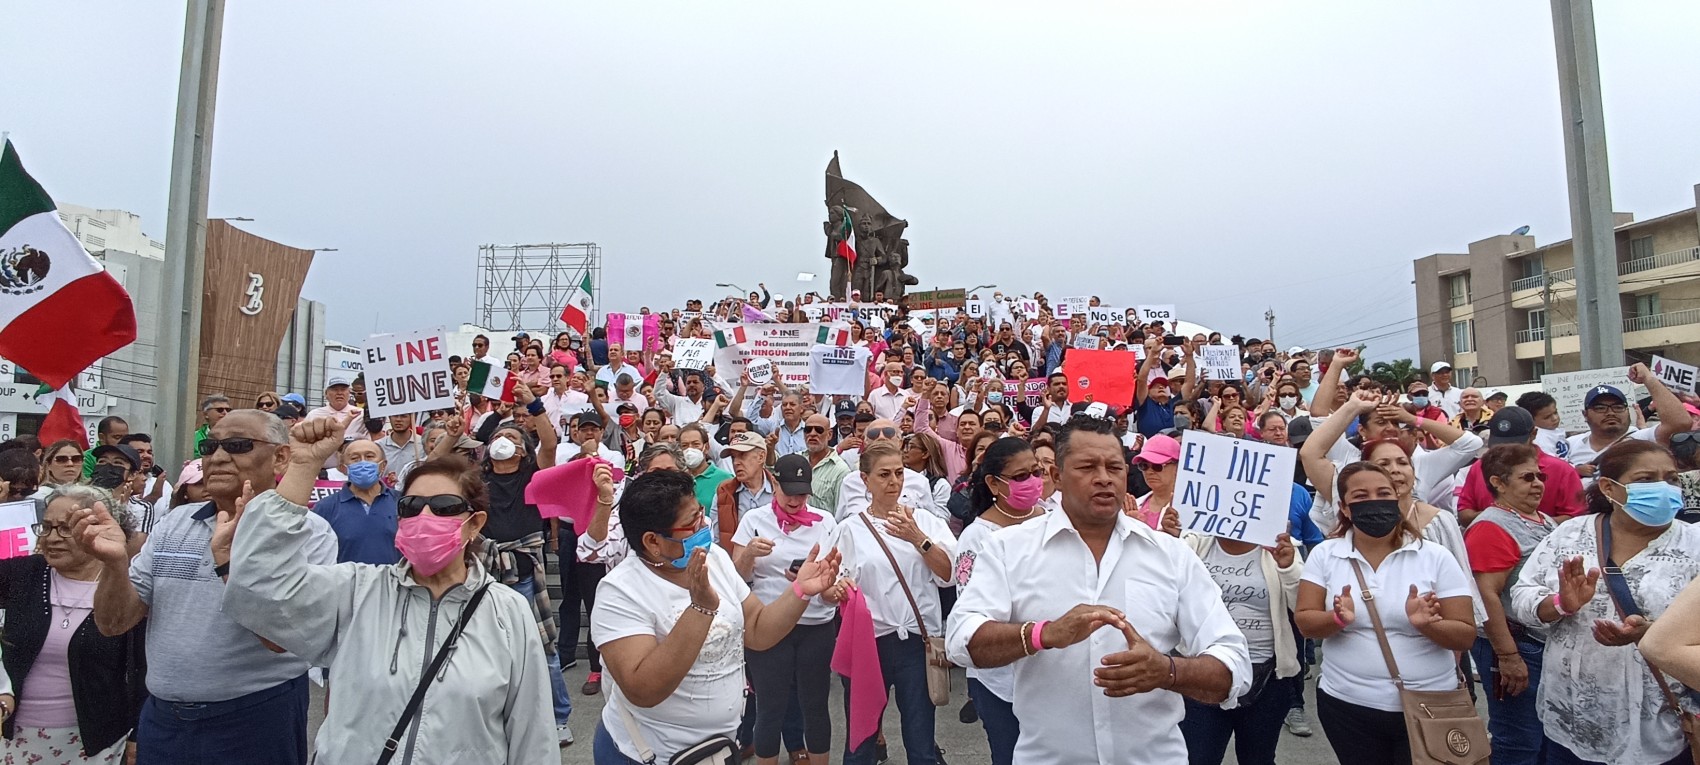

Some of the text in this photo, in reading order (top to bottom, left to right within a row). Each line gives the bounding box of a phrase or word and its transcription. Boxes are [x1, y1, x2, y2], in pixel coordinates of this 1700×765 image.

[1023, 302, 1036, 313] N
[1057, 304, 1068, 316] E
[1072, 304, 1084, 313] NE
[1143, 308, 1170, 319] Toca
[1091, 311, 1108, 321] No
[1110, 311, 1124, 322] Se
[780, 329, 800, 337] INE
[367, 336, 443, 367] EL INE
[1217, 367, 1235, 379] INE
[1663, 364, 1693, 386] INE
[386, 370, 451, 405] UNE
[1183, 442, 1206, 475] EL
[1181, 480, 1265, 520] NO SE
[1188, 510, 1248, 540] TOCA
